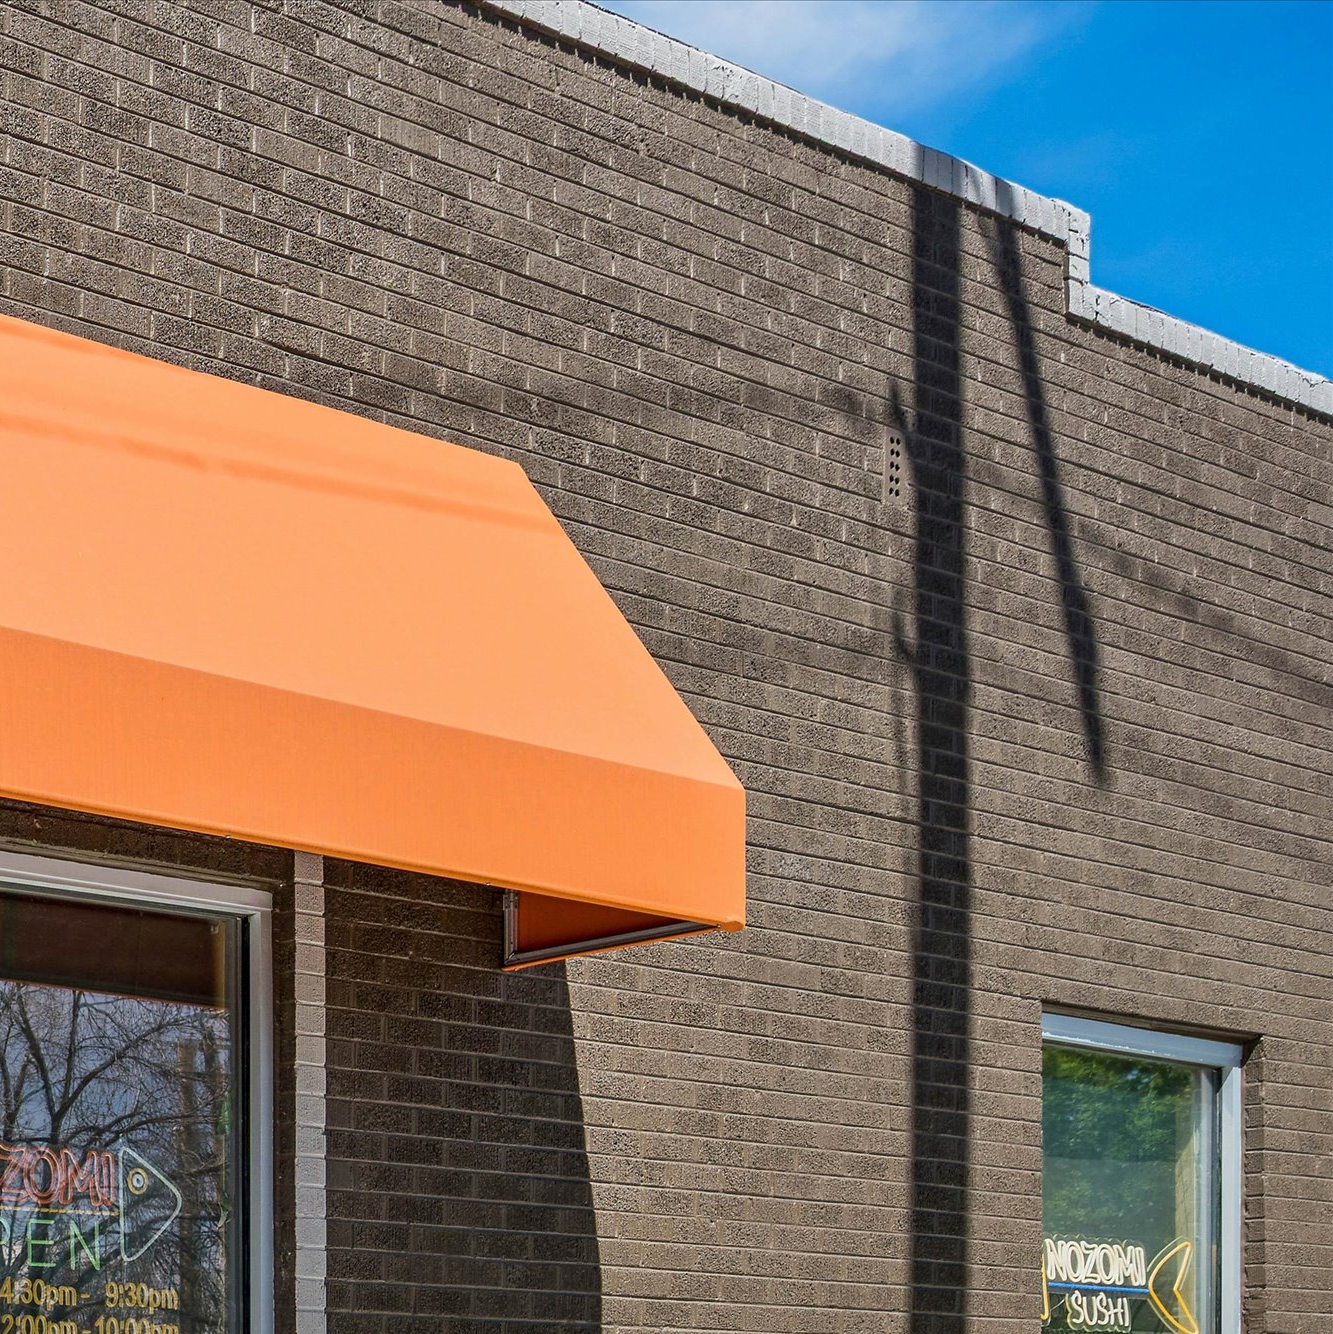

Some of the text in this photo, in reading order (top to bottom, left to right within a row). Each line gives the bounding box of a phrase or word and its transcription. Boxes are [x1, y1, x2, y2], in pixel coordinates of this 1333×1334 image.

[1044, 1238, 1146, 1286] NOZOMI
[105, 1281, 179, 1314] 9:30pm
[1071, 1290, 1129, 1326] SUSHI
